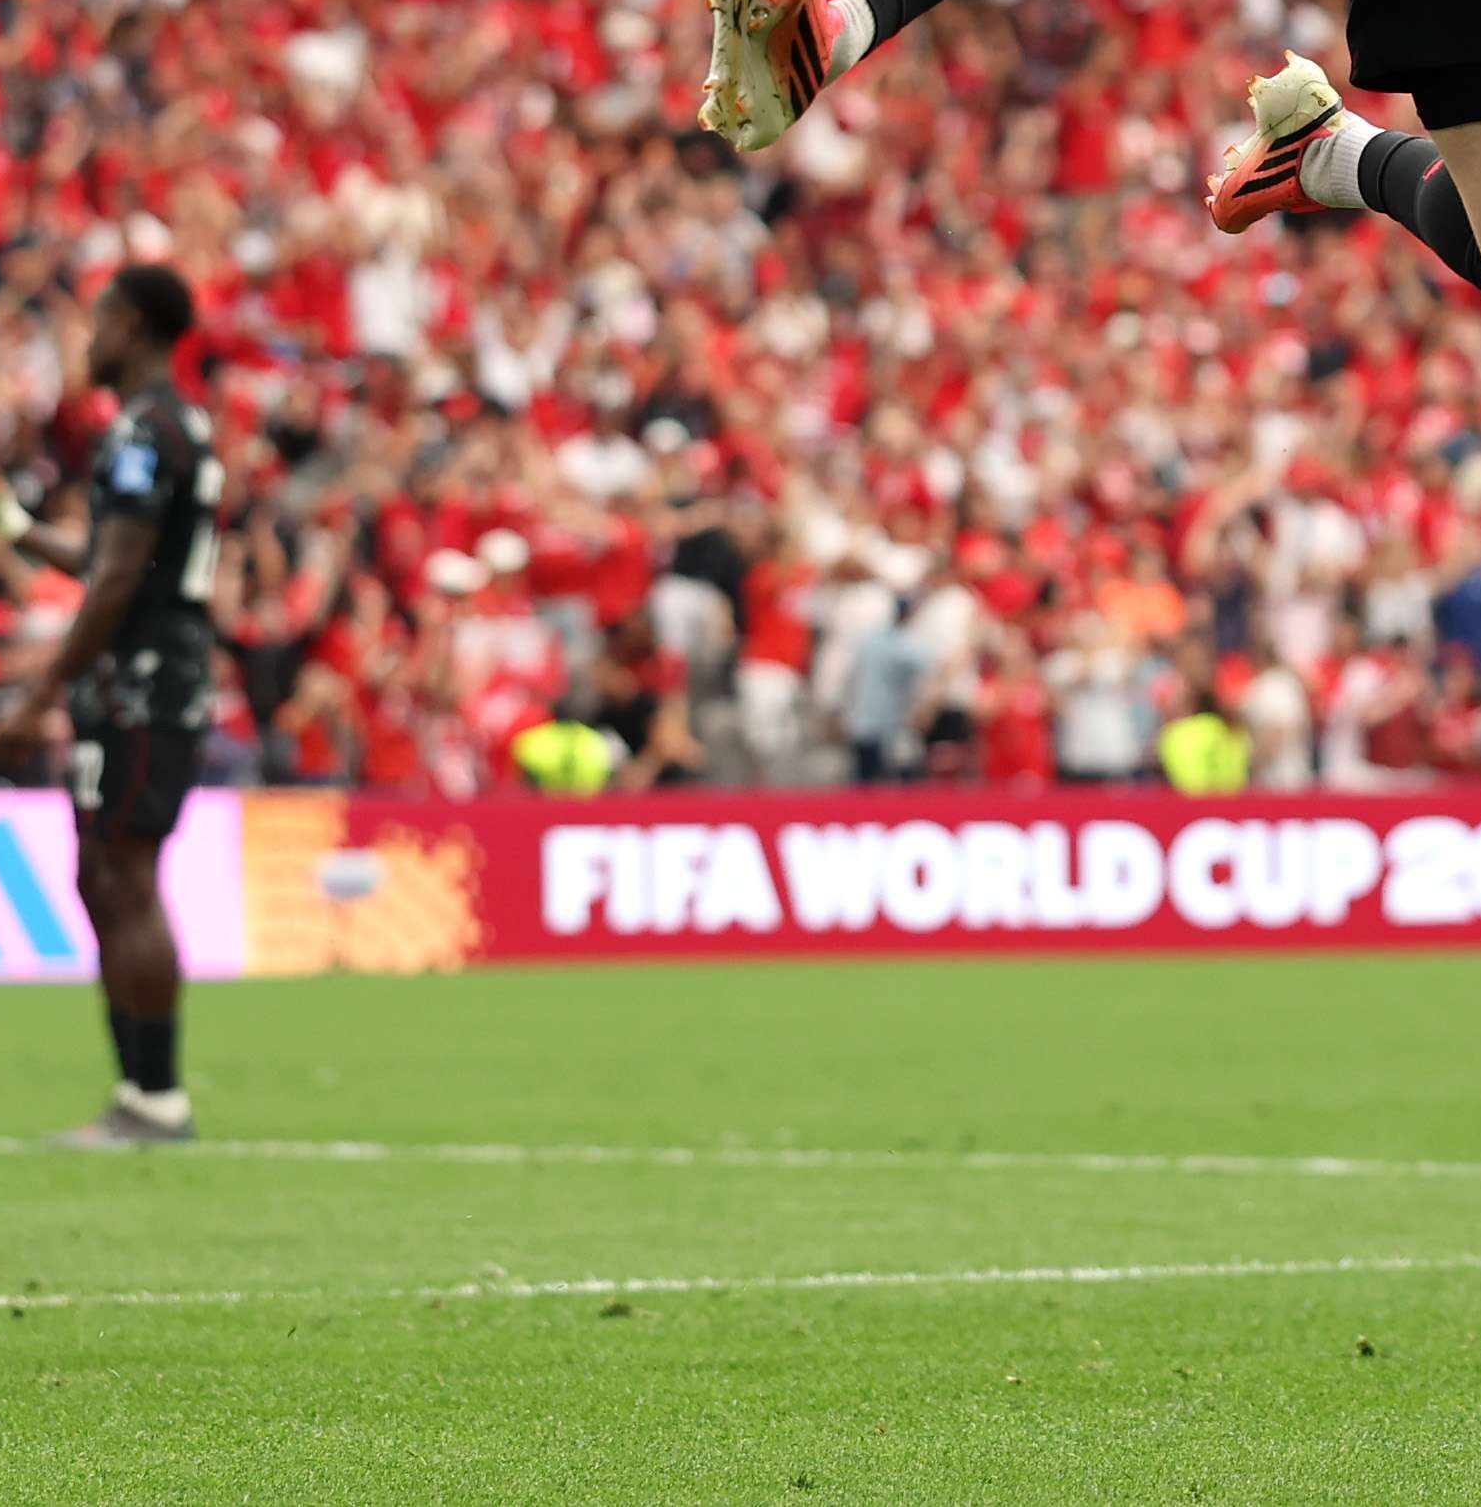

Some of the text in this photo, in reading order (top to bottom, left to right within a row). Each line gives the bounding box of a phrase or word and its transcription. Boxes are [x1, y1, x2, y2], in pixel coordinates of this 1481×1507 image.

[542, 823, 784, 935] FIFA
[777, 819, 1165, 933] WORLD
[1167, 817, 1381, 930] CUP
